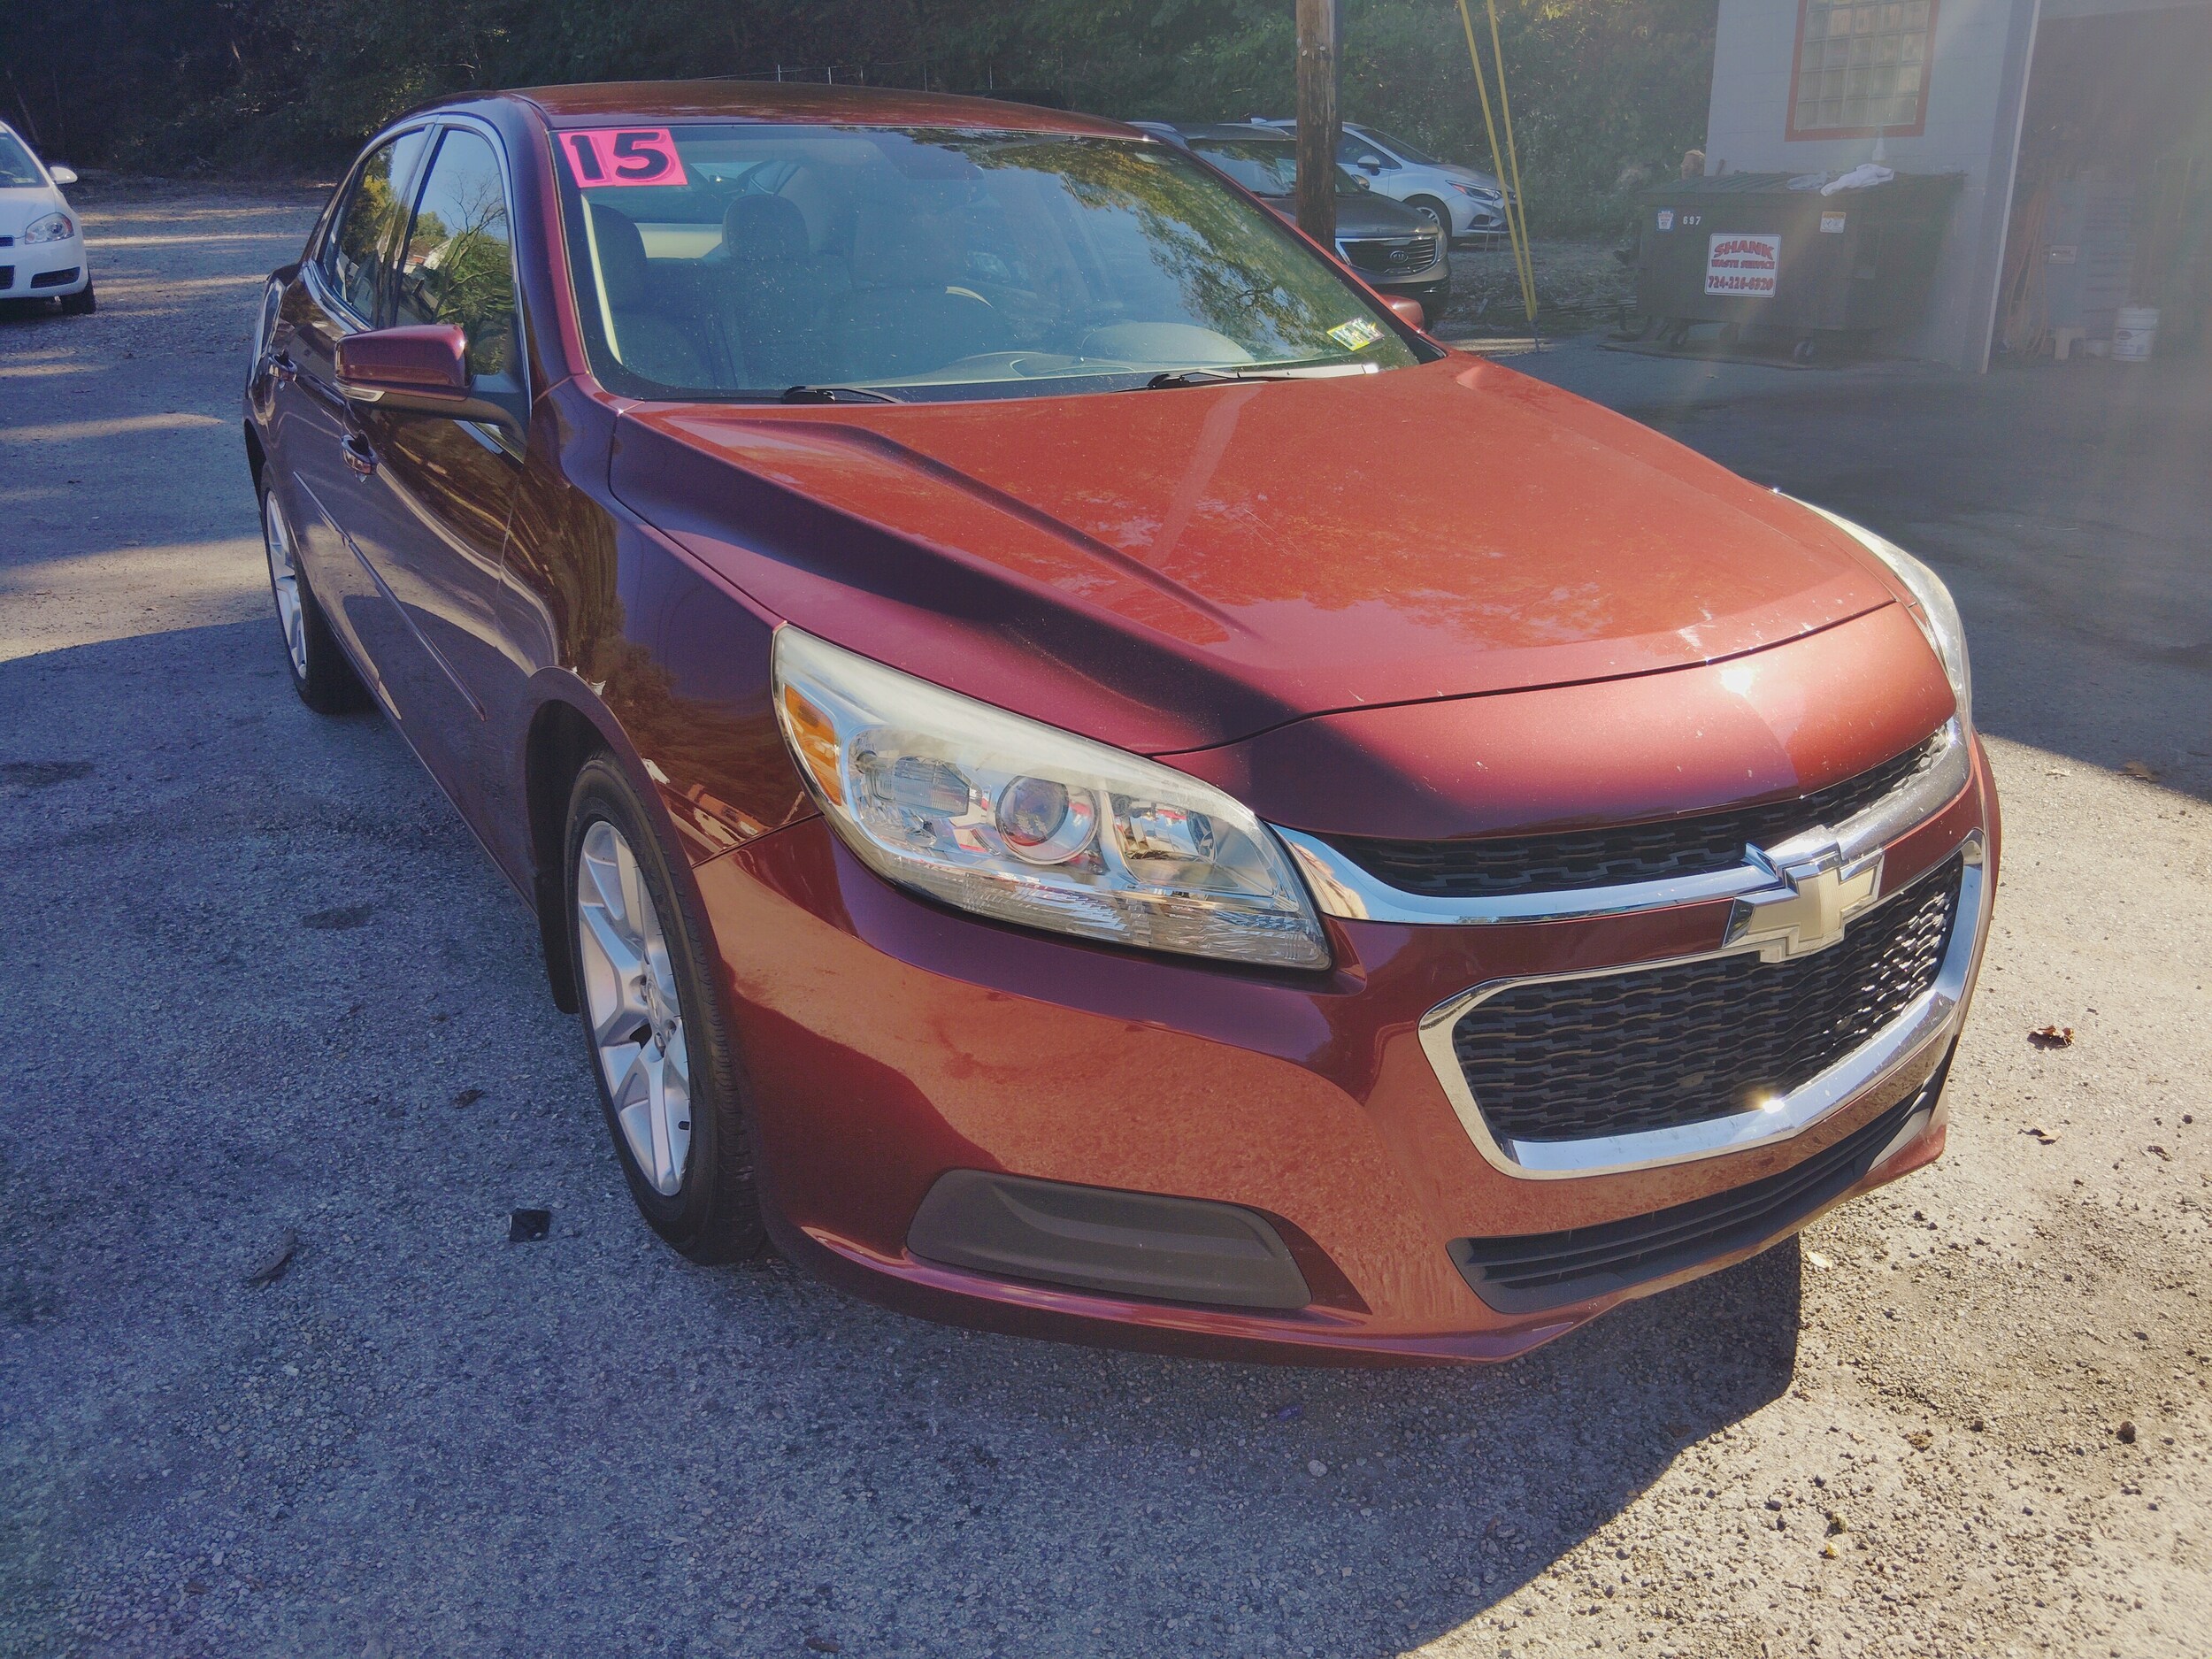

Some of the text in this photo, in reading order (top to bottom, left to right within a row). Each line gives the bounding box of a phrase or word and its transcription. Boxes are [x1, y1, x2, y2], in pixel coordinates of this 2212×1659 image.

[570, 132, 673, 180] 15
[1683, 216, 1701, 226] 697
[1714, 240, 1775, 261] SHANK
[1711, 259, 1776, 270] WASTE SERVICE
